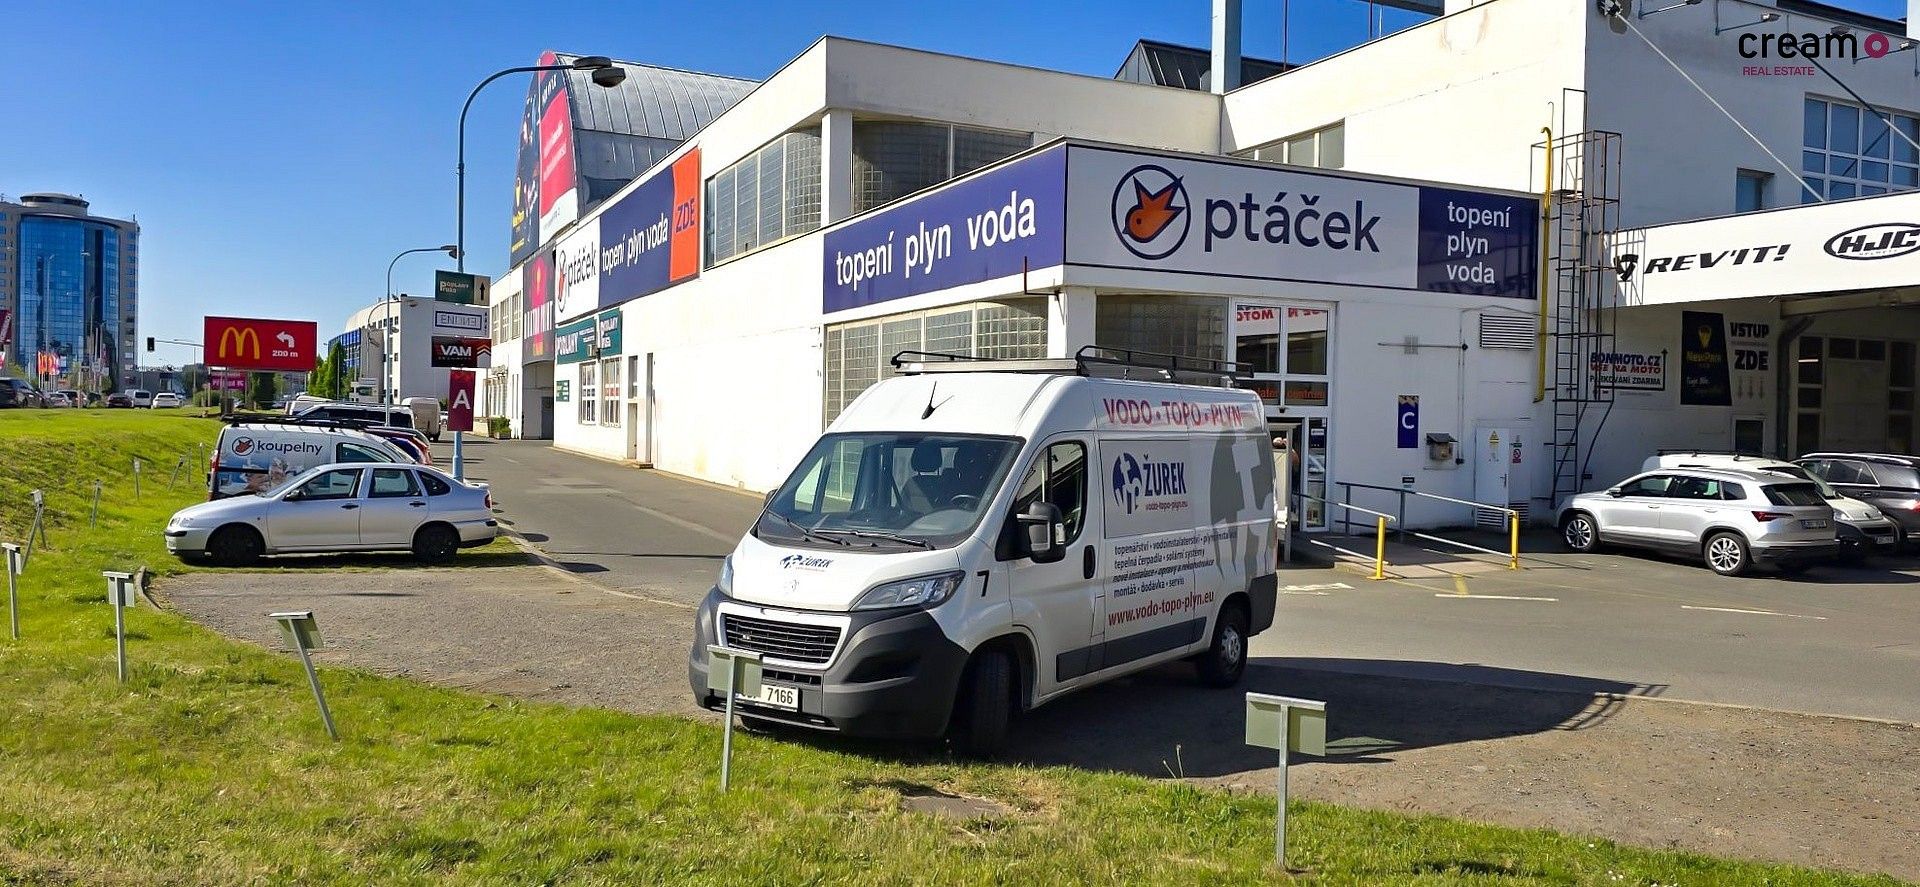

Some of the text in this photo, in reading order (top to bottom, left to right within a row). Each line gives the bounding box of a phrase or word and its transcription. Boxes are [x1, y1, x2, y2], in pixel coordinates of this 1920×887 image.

[676, 199, 695, 233] ZDE
[1205, 192, 1380, 253] ptáček
[1447, 201, 1510, 229] topení
[602, 213, 669, 275] topení plyn voda
[836, 191, 1036, 291] topení plyn voda
[1447, 230, 1489, 256] plyn
[1838, 230, 1920, 254] HJC
[568, 242, 597, 297] ptáček
[1644, 244, 1791, 274] REV'IT!
[1447, 262, 1496, 284] voda
[1730, 322, 1770, 338] VSTUP
[441, 345, 471, 357] VAM
[1734, 350, 1769, 370] ZDE
[1631, 365, 1661, 374] MOTO
[1632, 377, 1661, 385] ZDARMA
[452, 389, 471, 409] A
[1103, 399, 1242, 427] VODO TOPO PLYN
[1402, 412, 1415, 429] C
[258, 440, 323, 455] koupelny
[1144, 454, 1187, 496] ŽUREK
[1114, 557, 1137, 570] tepelná
[977, 569, 990, 597] 7
[1114, 584, 1137, 598] montáž
[1141, 579, 1165, 593] dodávka
[1108, 590, 1214, 626] www.vodo-topo-plyn.eu
[767, 687, 793, 705] 7166
